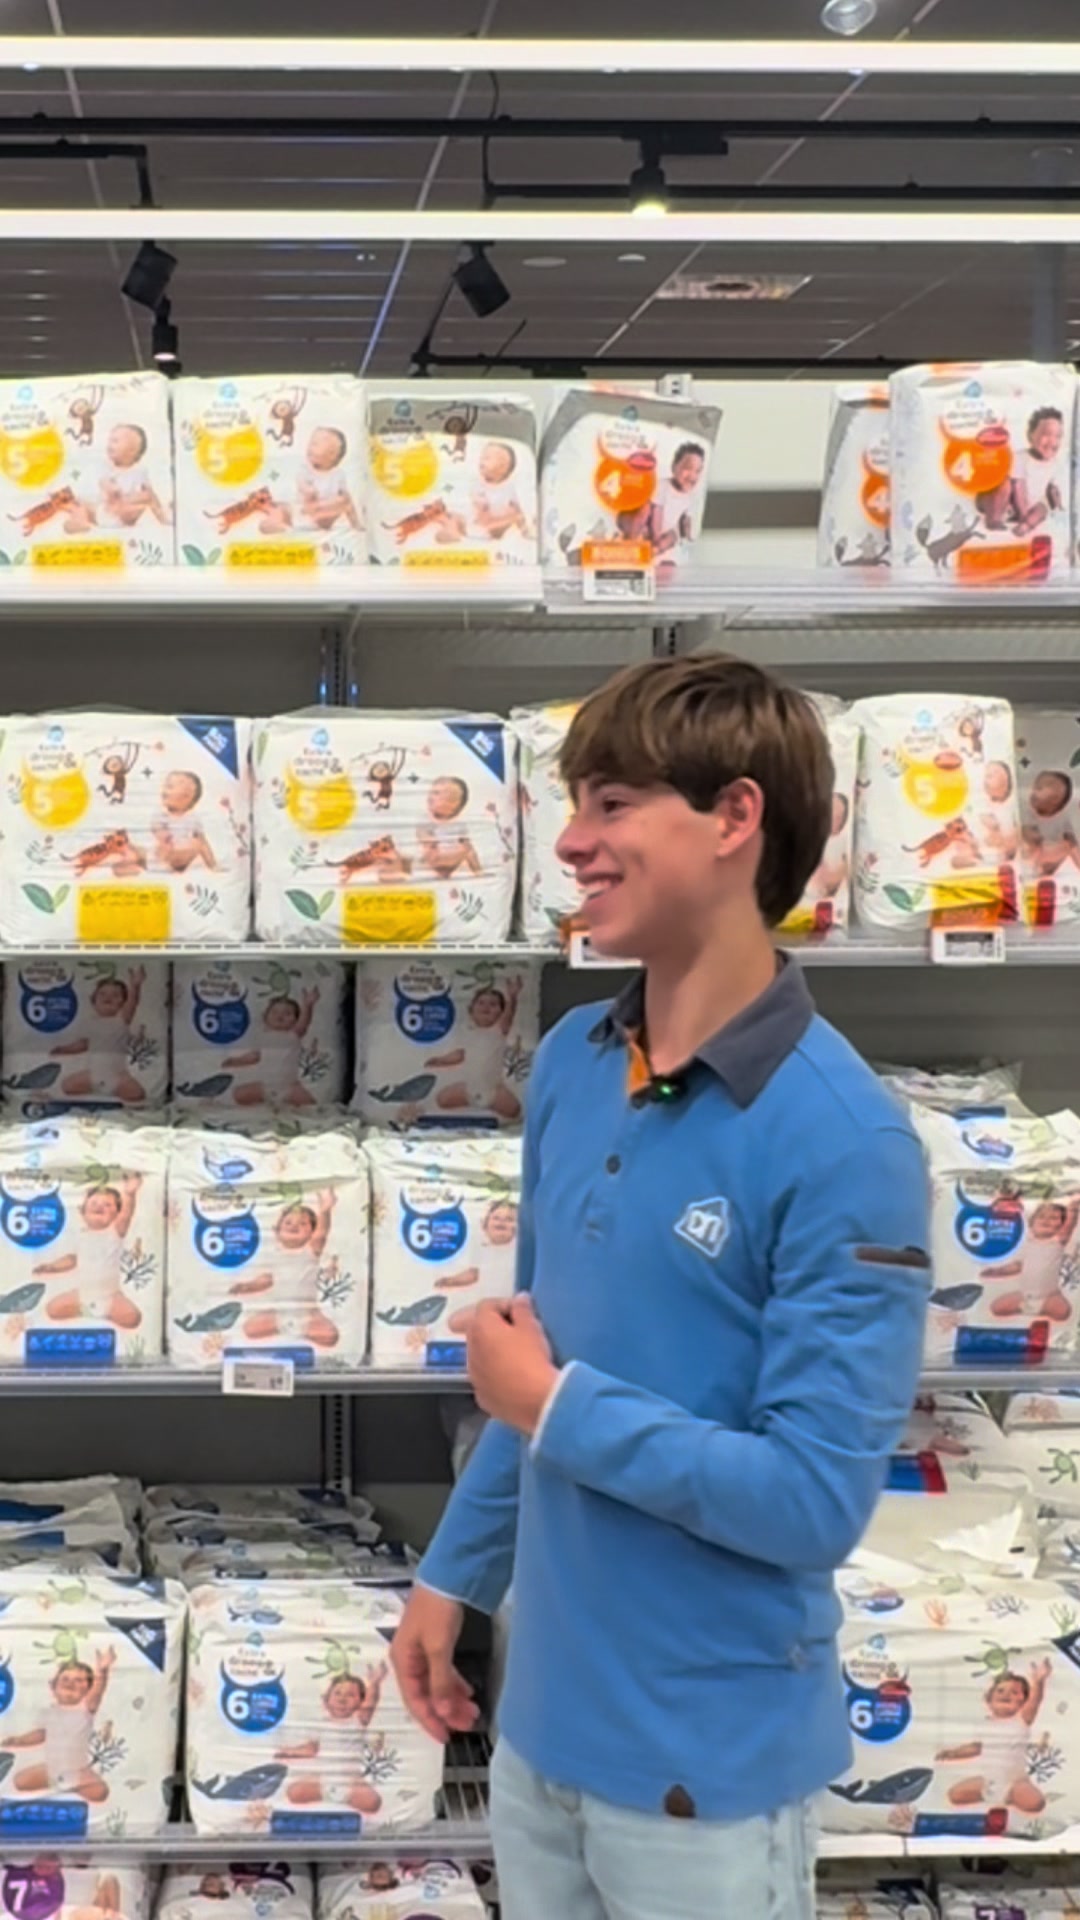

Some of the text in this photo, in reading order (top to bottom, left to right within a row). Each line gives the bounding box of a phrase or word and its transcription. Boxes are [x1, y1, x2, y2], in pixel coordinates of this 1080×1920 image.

[951, 451, 974, 482] 4
[600, 470, 621, 499] 4
[915, 774, 937, 804] 5
[26, 995, 47, 1024] 6
[199, 1008, 219, 1034] 6
[402, 1004, 422, 1033] 6
[7, 1205, 30, 1237] 6
[409, 1218, 432, 1249] 6
[962, 1218, 986, 1248] 6
[201, 1227, 225, 1257] 6
[227, 1689, 249, 1720] 6
[851, 1699, 873, 1730] 6
[8, 1879, 28, 1912] 7
